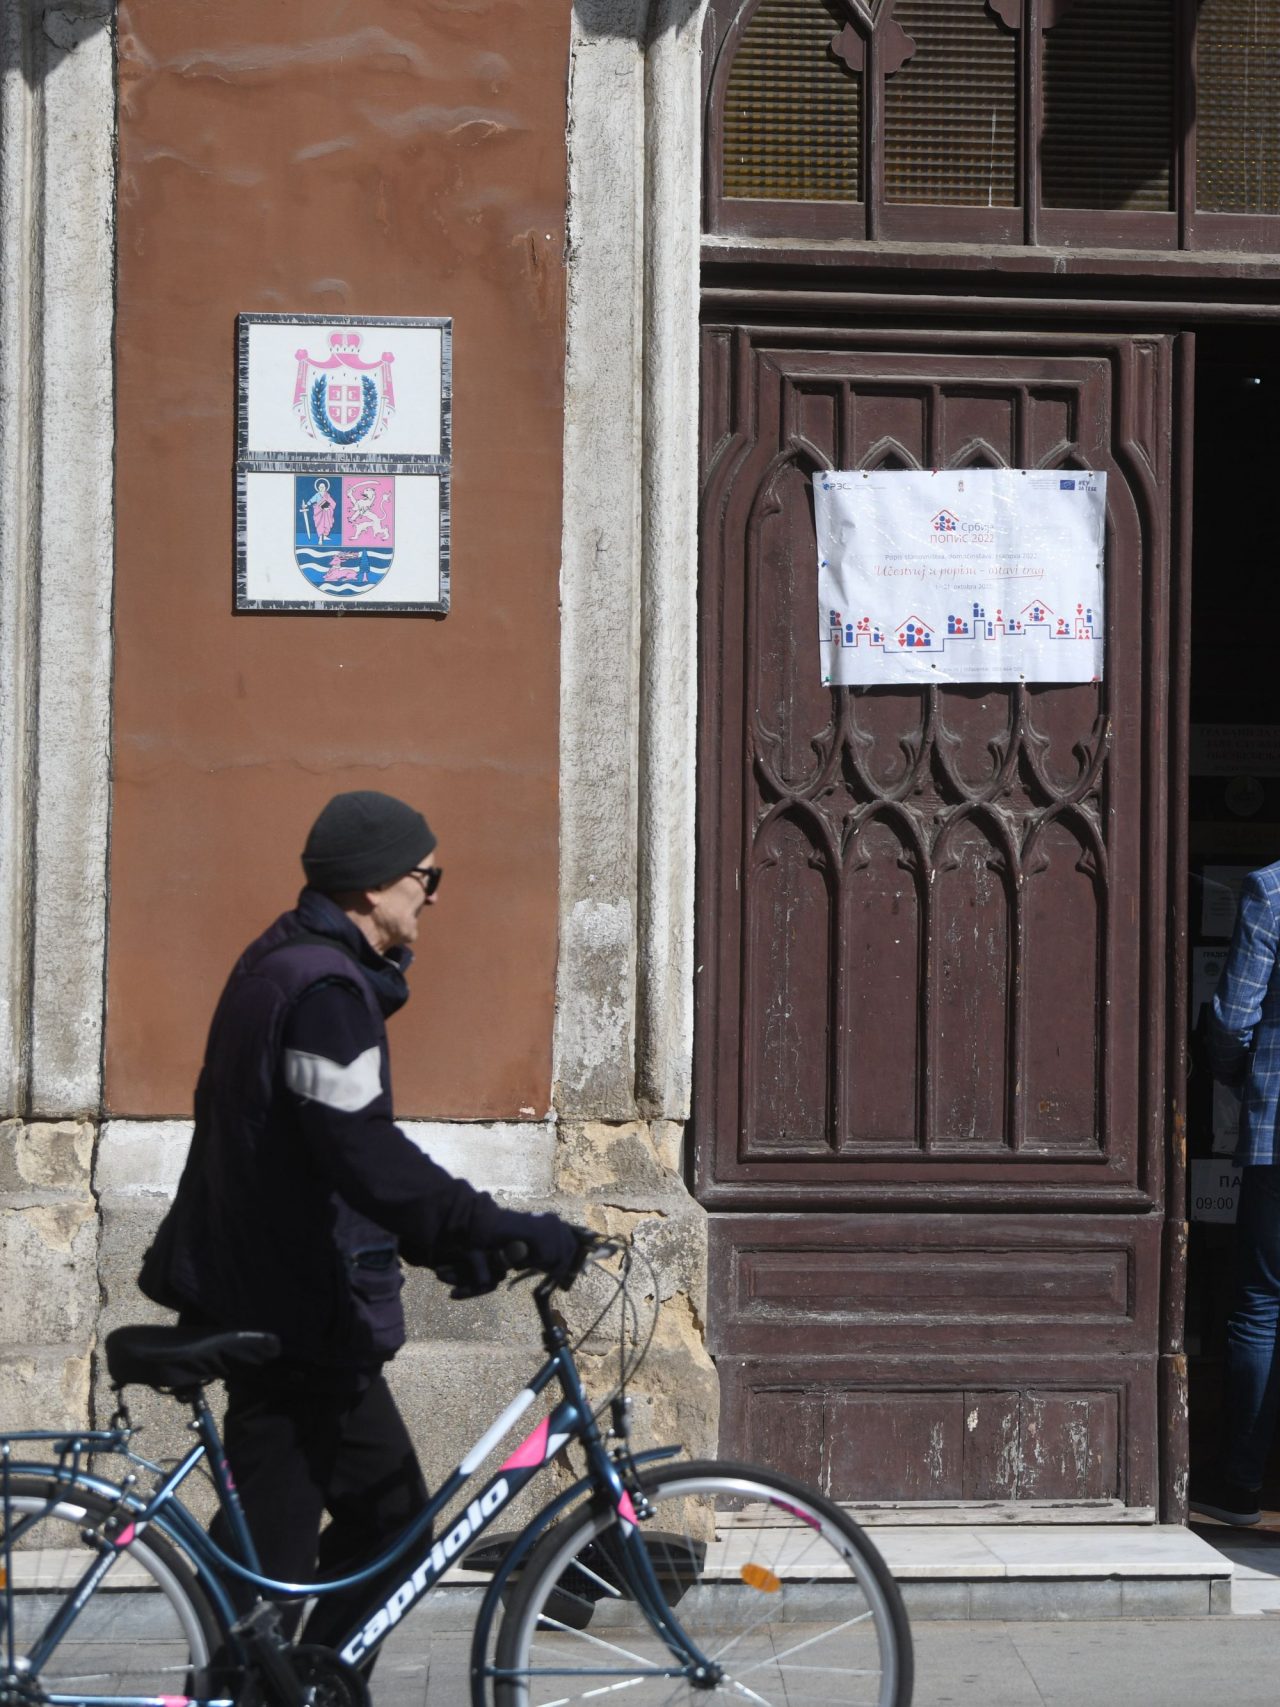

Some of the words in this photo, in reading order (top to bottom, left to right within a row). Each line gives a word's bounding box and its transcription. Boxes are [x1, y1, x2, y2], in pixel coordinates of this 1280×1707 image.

[971, 533, 994, 543] 2022
[1195, 1196, 1233, 1210] 09:00
[340, 1478, 509, 1664] capriolo
